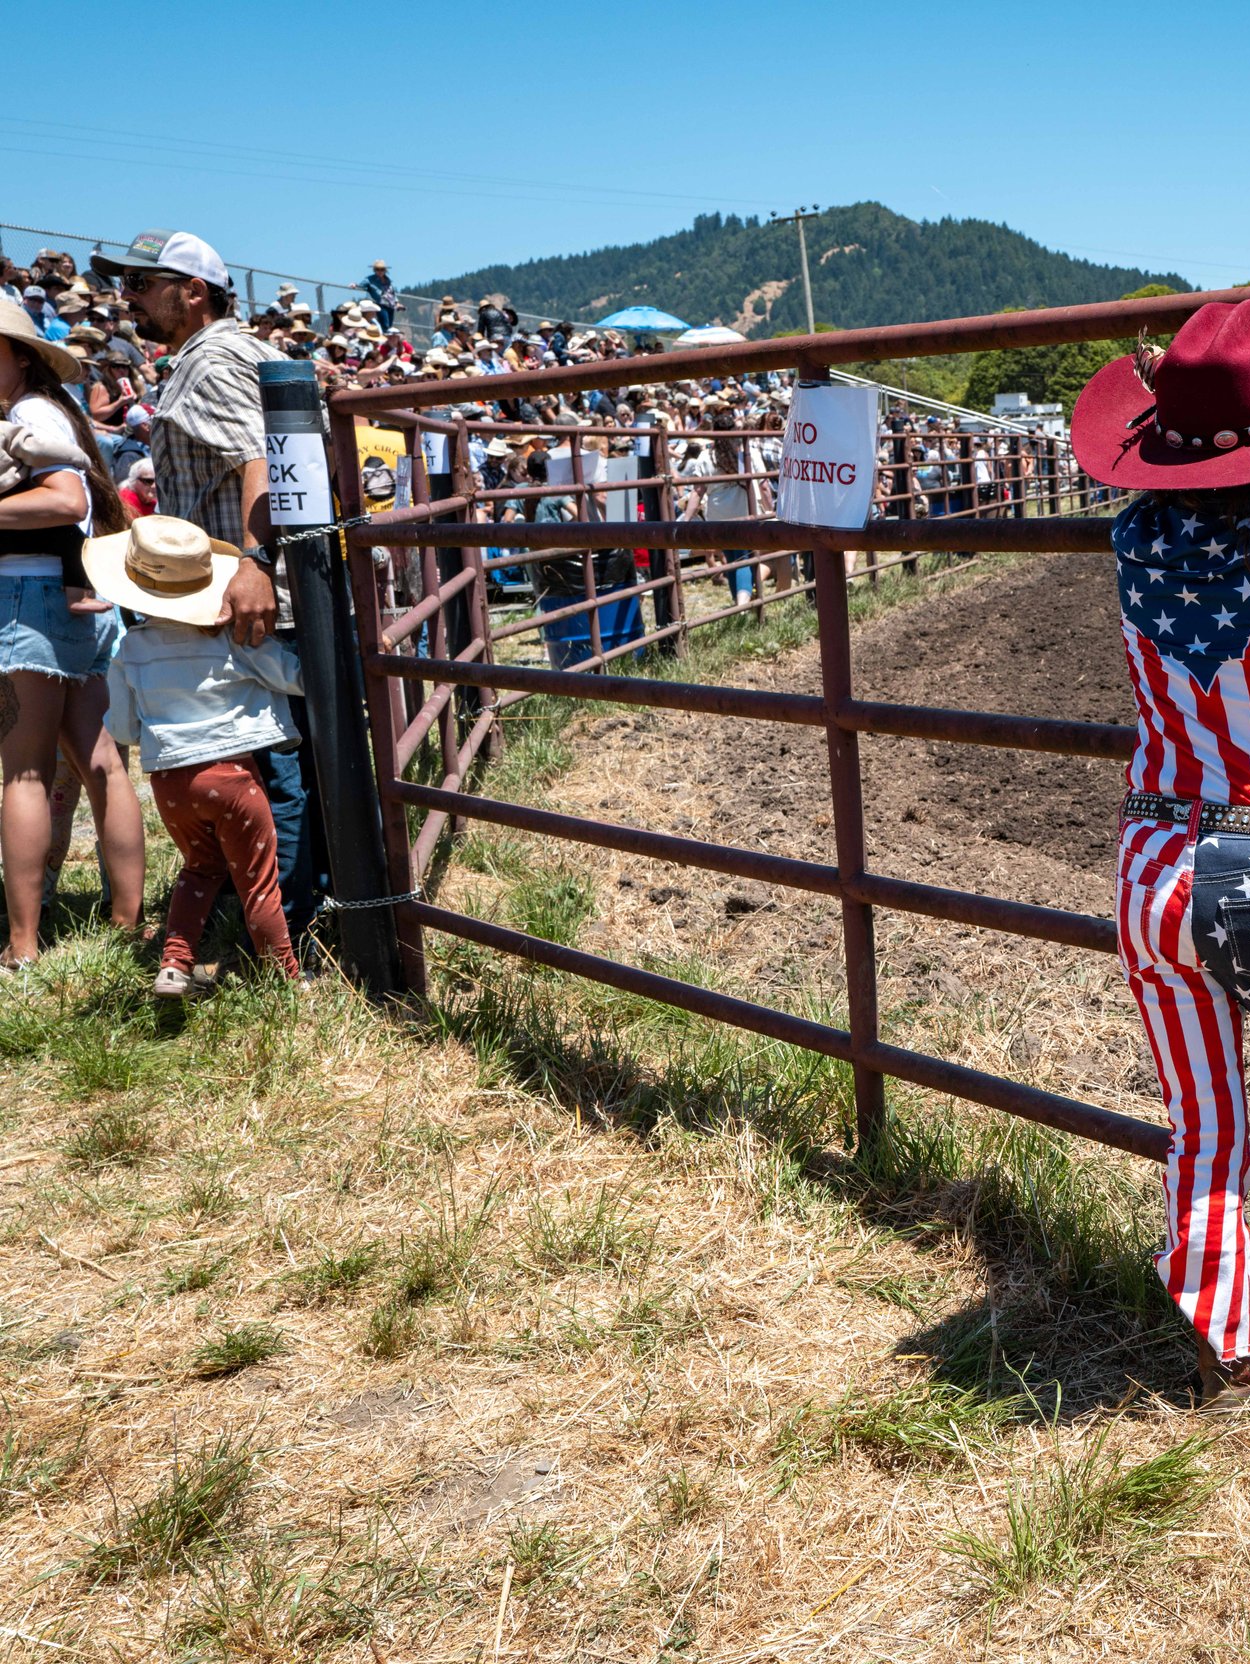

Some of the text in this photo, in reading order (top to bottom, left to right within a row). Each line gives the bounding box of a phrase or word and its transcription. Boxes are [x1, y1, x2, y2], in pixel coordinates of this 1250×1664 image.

[793, 422, 818, 445] NO
[266, 435, 288, 455] AY
[374, 444, 399, 456] CIRC
[268, 463, 299, 483] CK
[783, 457, 856, 486] SMOKING
[270, 491, 307, 511] EET
